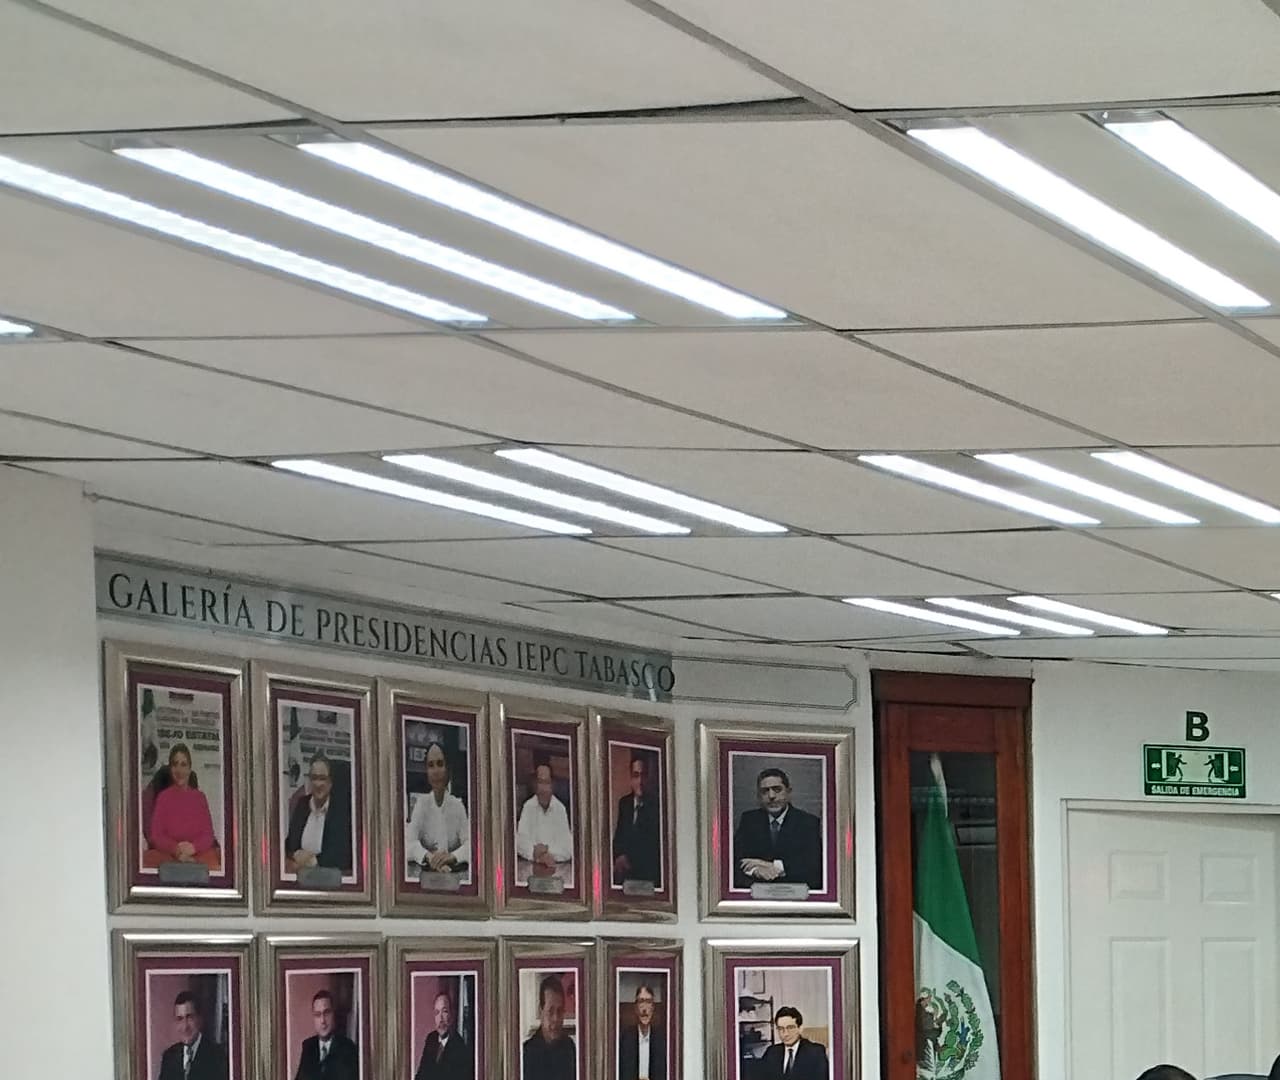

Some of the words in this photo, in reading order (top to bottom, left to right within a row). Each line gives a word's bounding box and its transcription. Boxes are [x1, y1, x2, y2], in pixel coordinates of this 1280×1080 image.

[108, 573, 255, 630] GALERÍA
[266, 600, 305, 638] DE
[316, 608, 508, 668] PRESIDENCIAS
[517, 641, 569, 676] IEPC
[574, 651, 676, 692] TABASCO
[1186, 711, 1210, 741] B
